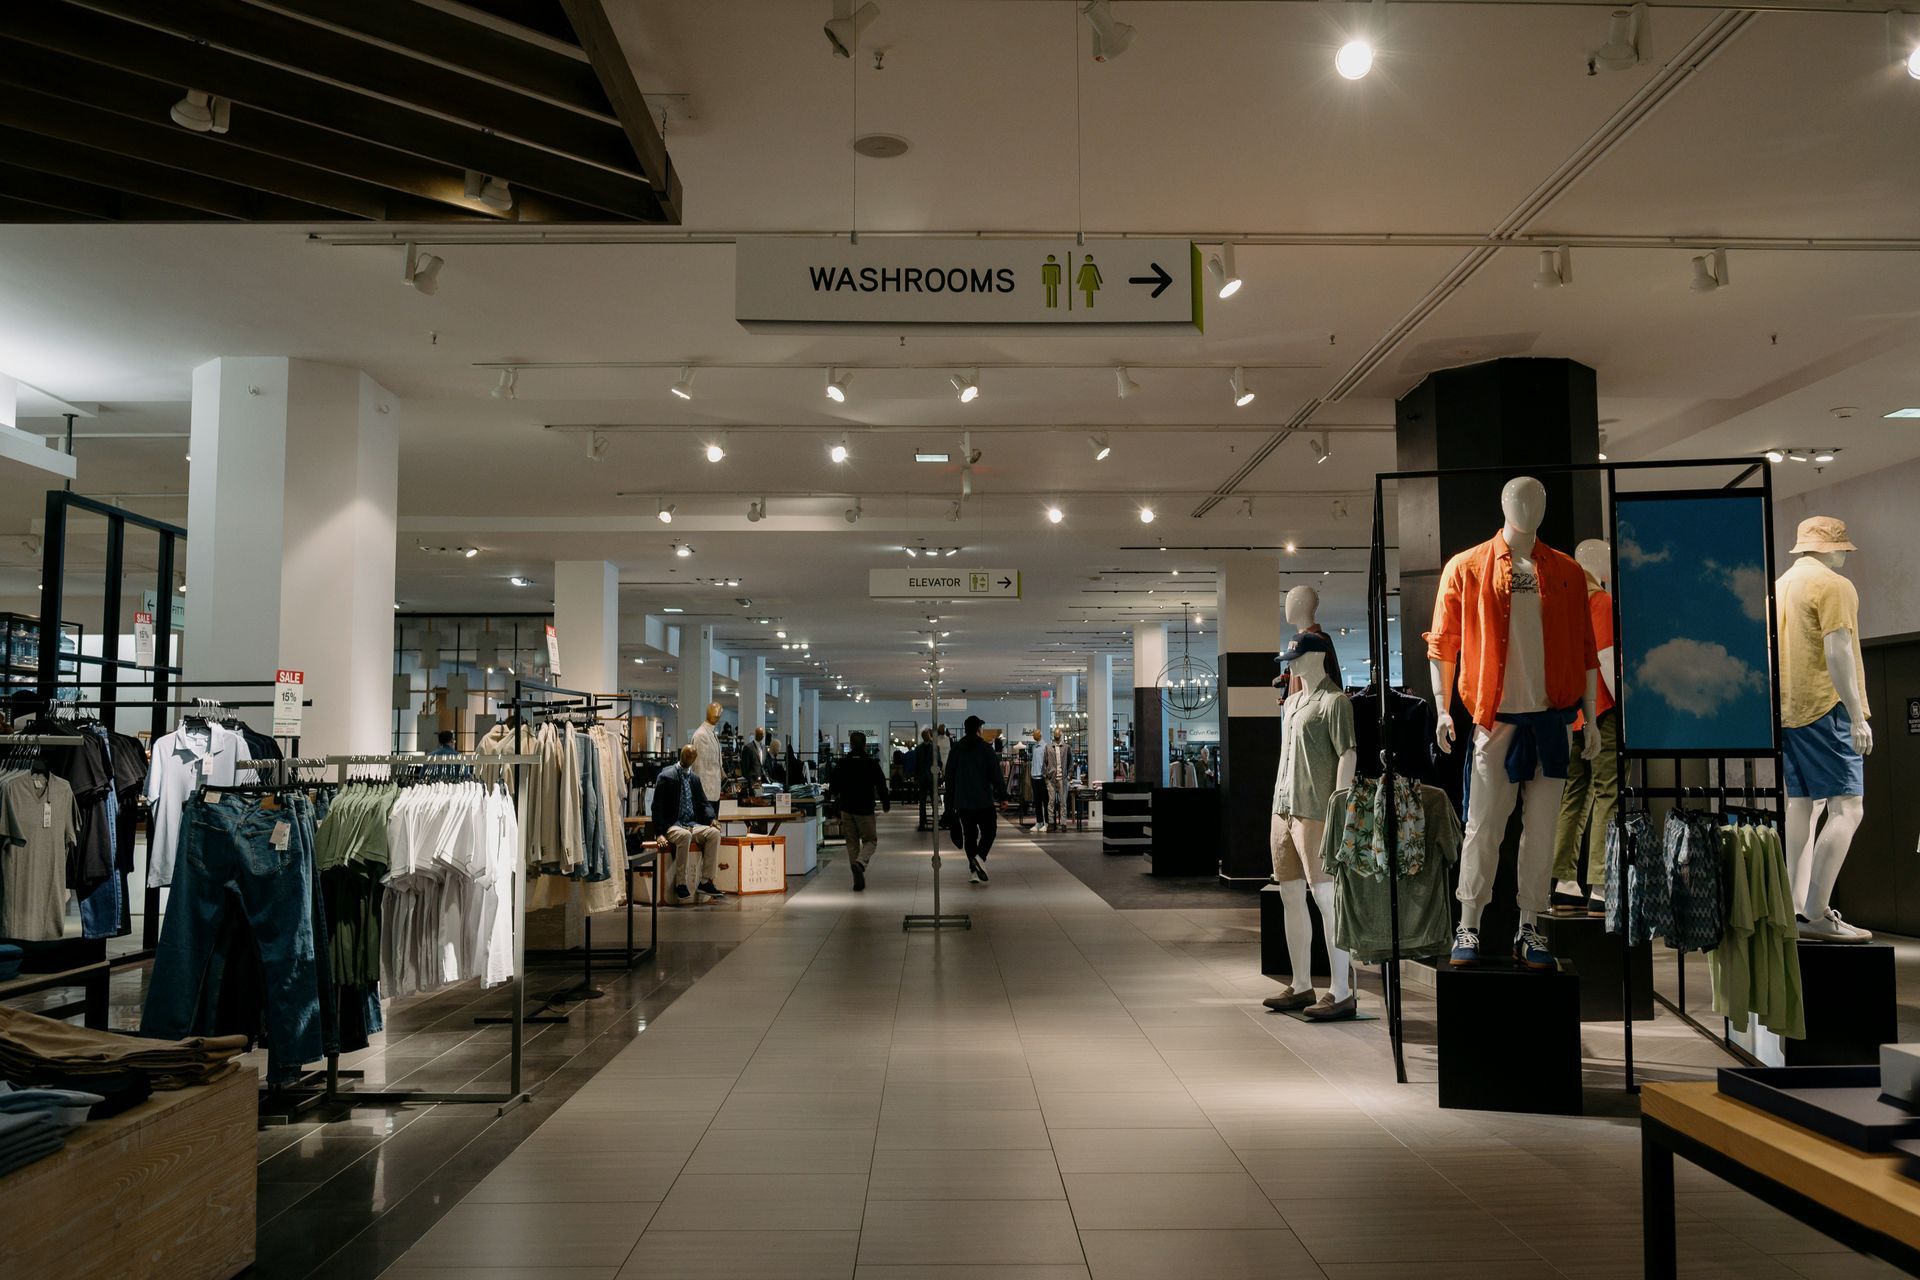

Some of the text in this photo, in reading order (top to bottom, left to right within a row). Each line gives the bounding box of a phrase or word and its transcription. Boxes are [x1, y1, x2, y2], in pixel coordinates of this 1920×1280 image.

[809, 266, 1015, 293] WASHROOMS
[909, 577, 961, 587] ELEVATOR
[136, 613, 151, 624] SALE
[279, 671, 301, 684] SALE
[282, 691, 297, 702] 15%
